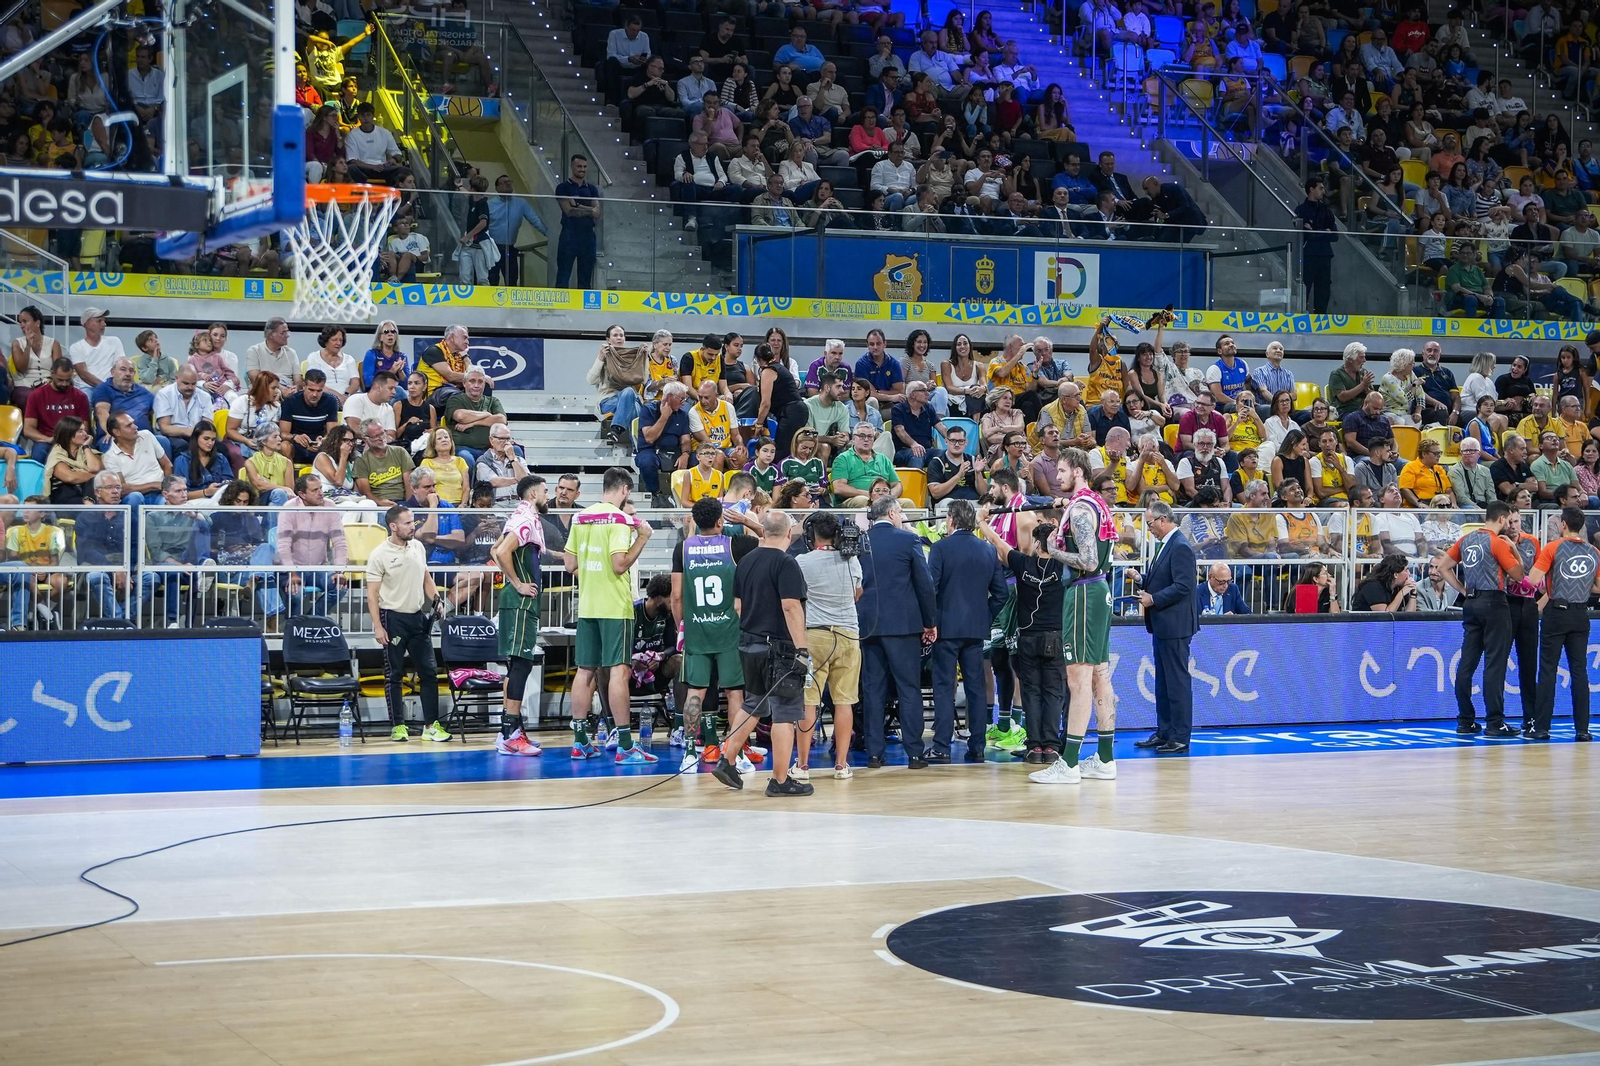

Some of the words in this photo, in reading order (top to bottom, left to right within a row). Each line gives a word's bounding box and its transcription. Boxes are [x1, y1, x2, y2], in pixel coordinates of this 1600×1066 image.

[164, 278, 189, 290] GRAN
[190, 279, 230, 292] CANARIA
[511, 289, 533, 302] GRAN
[534, 290, 571, 303] CANARIA
[825, 302, 847, 313] GRAN
[847, 302, 880, 315] CANARIA
[477, 359, 507, 369] CA
[688, 544, 725, 555] CASTAÑEDA
[1467, 548, 1478, 563] 78
[1570, 560, 1588, 574] 66
[694, 575, 724, 607] 13
[1312, 975, 1451, 993] STUDIOS
[1479, 968, 1525, 979] VR
